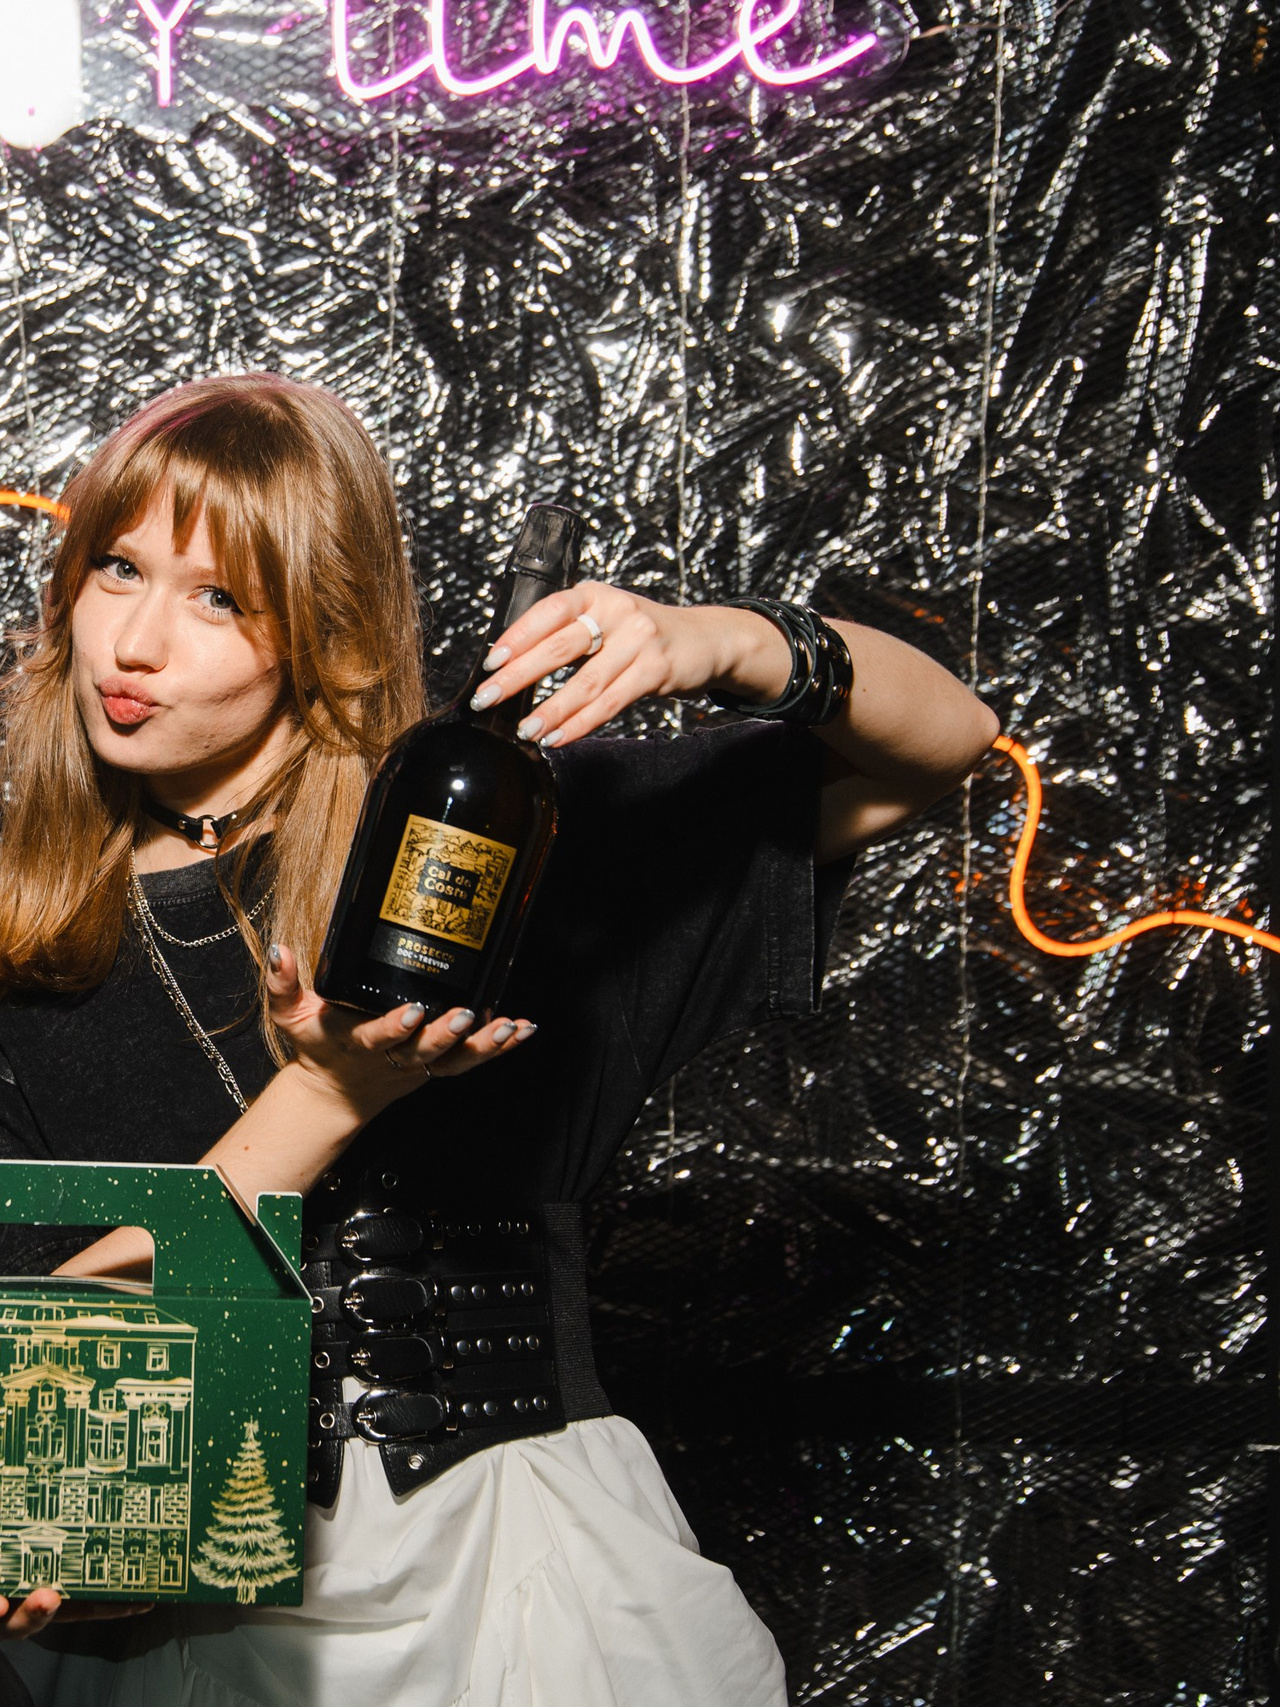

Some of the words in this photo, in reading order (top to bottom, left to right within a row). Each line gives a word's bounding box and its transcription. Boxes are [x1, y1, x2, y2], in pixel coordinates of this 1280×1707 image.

[397, 947, 413, 958] DOC
[419, 954, 449, 969] TREVISO
[398, 937, 454, 963] PROSECCO
